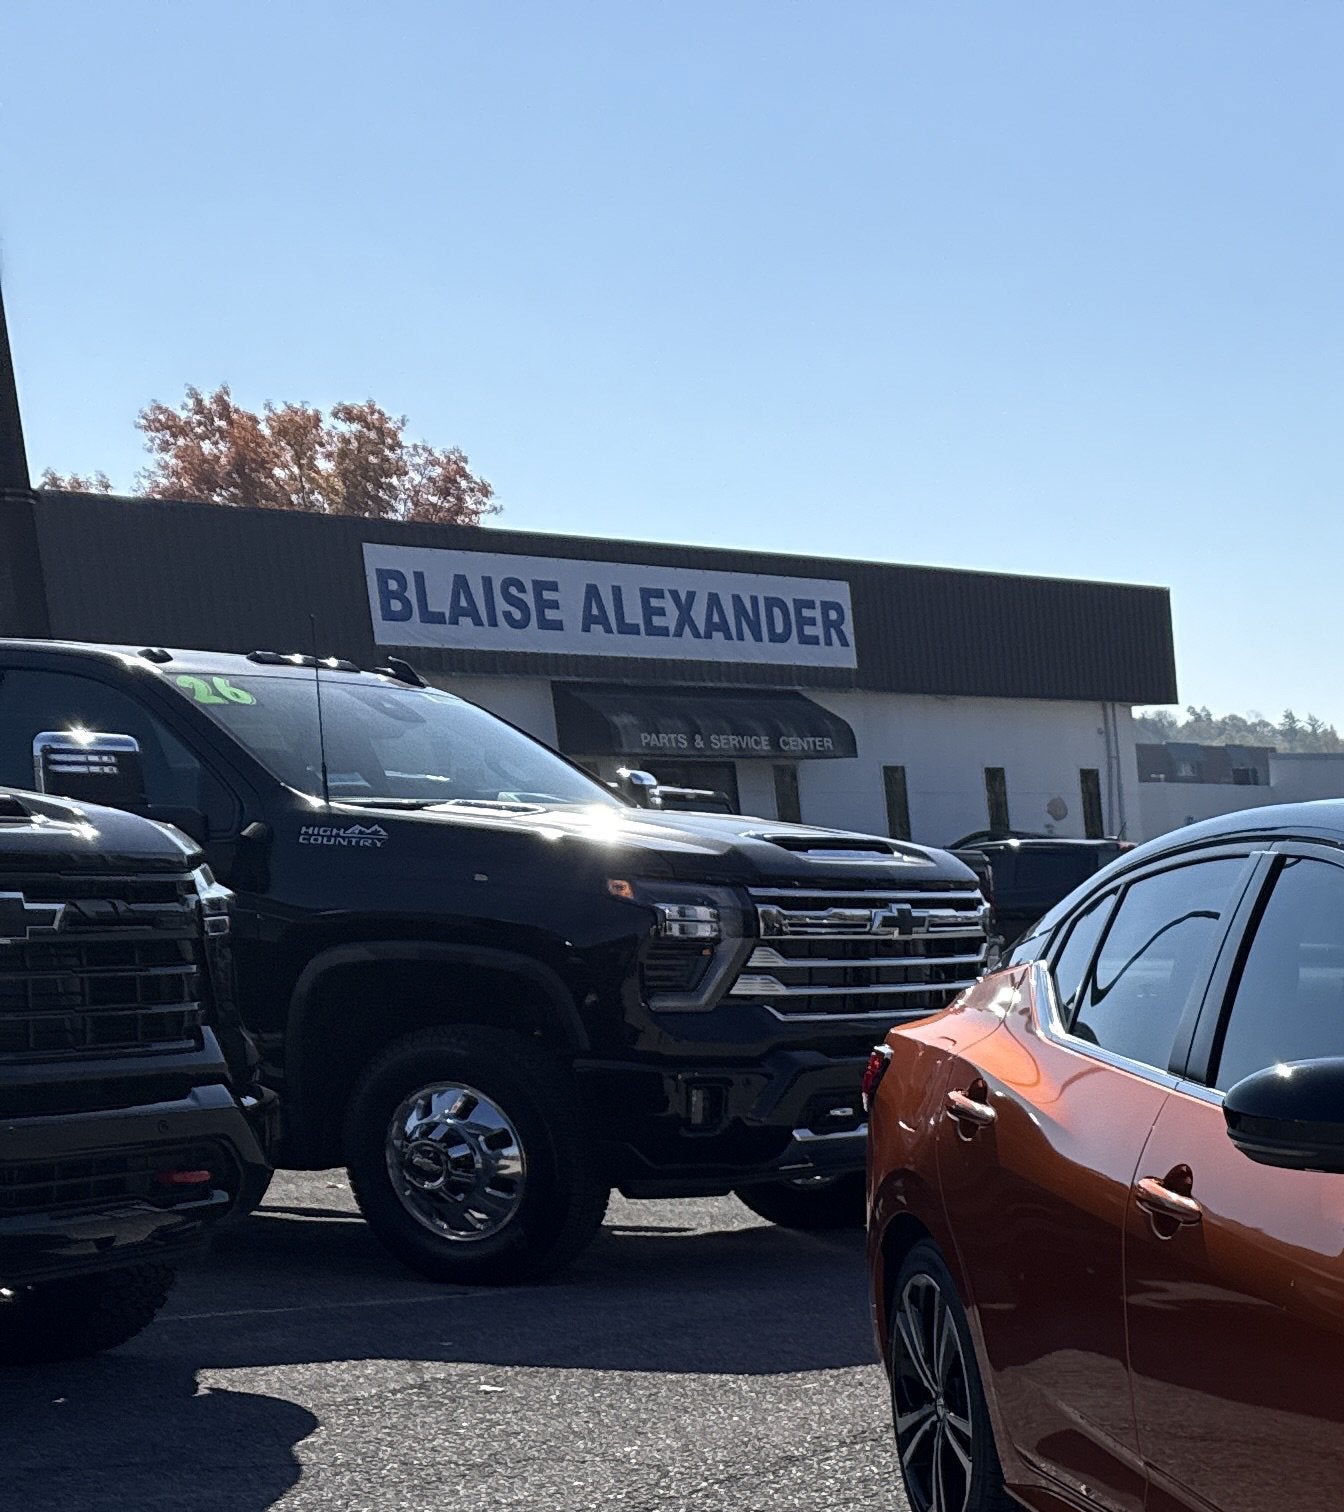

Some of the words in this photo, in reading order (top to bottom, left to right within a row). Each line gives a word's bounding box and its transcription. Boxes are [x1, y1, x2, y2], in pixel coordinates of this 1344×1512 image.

[376, 567, 564, 632] BLAISE
[581, 583, 850, 647] ALEXANDER
[176, 675, 257, 705] 26
[641, 733, 688, 748] PARTS
[695, 735, 704, 748] &
[711, 735, 770, 750] SERVICE
[779, 736, 833, 750] CENTER
[300, 826, 346, 836] HIGH
[299, 835, 387, 848] COUNTRY
